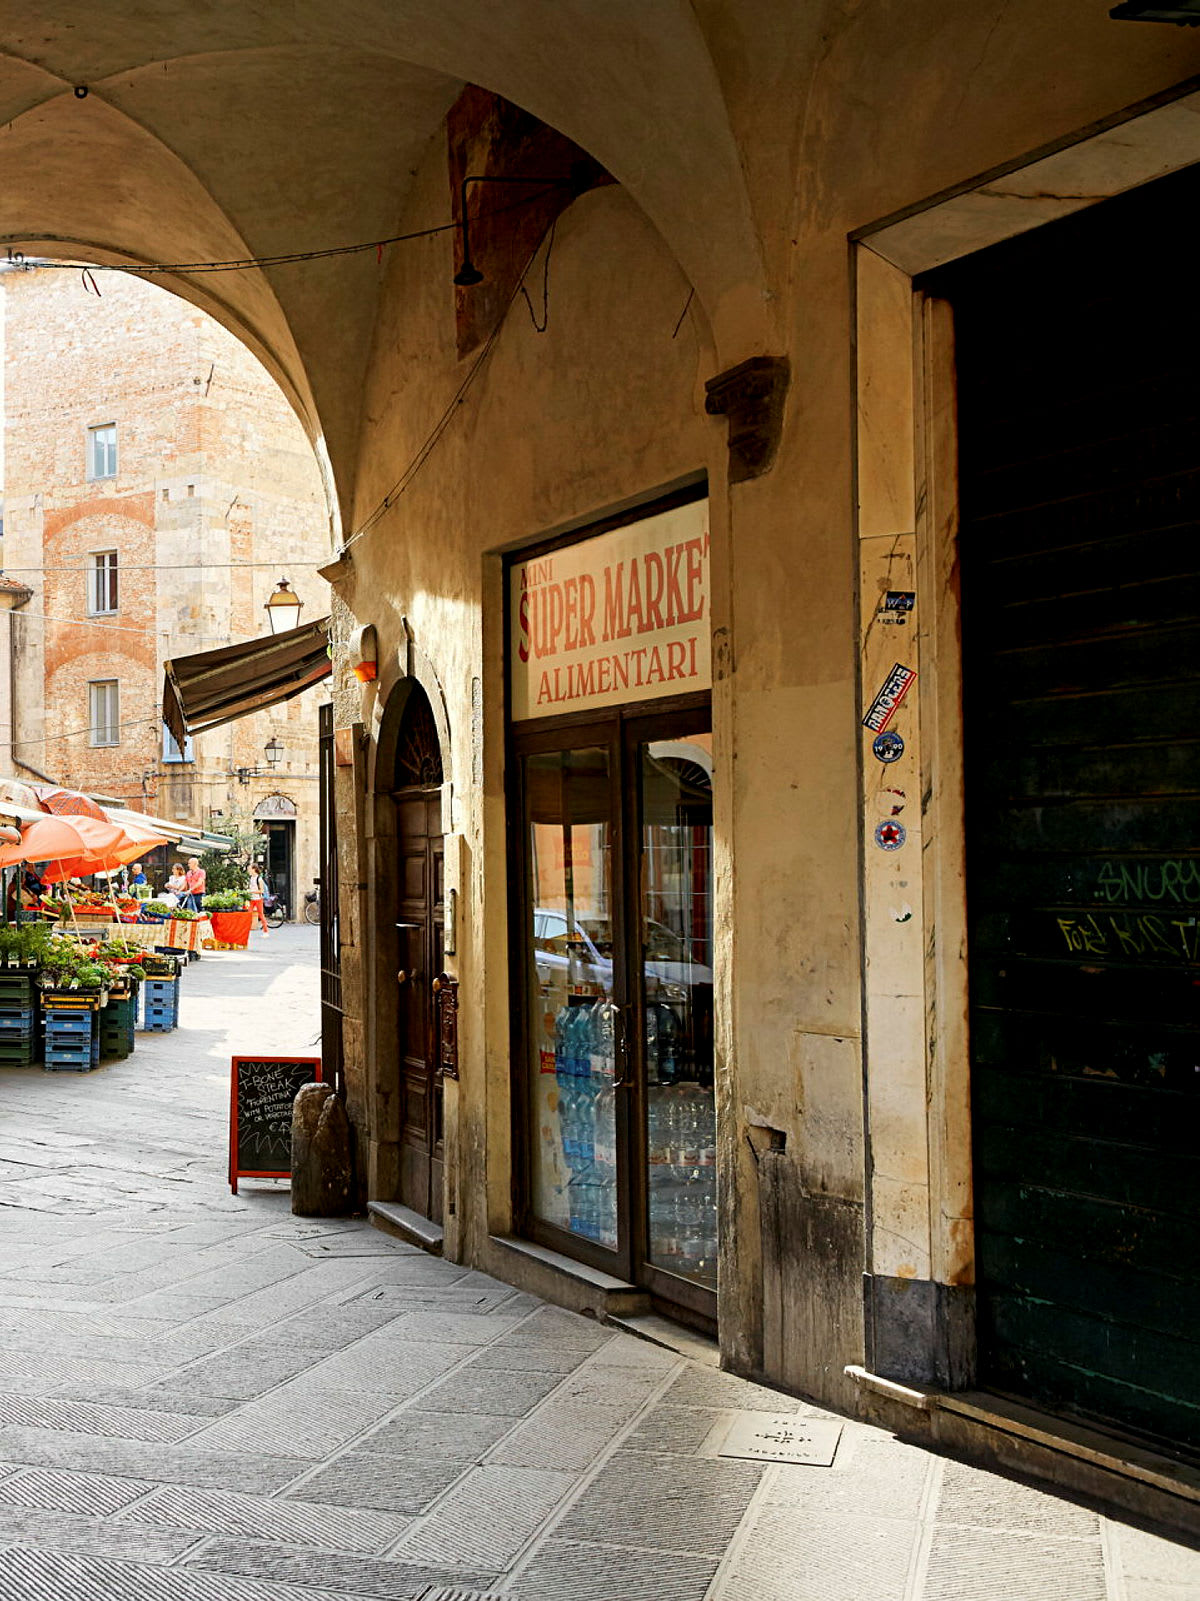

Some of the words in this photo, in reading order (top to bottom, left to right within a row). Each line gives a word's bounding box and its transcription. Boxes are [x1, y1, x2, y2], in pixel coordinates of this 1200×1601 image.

[518, 573, 596, 663] SUPER
[537, 637, 698, 705] ALIMENTARI
[239, 1071, 284, 1090] T-BONE
[257, 1078, 297, 1096] STEAK
